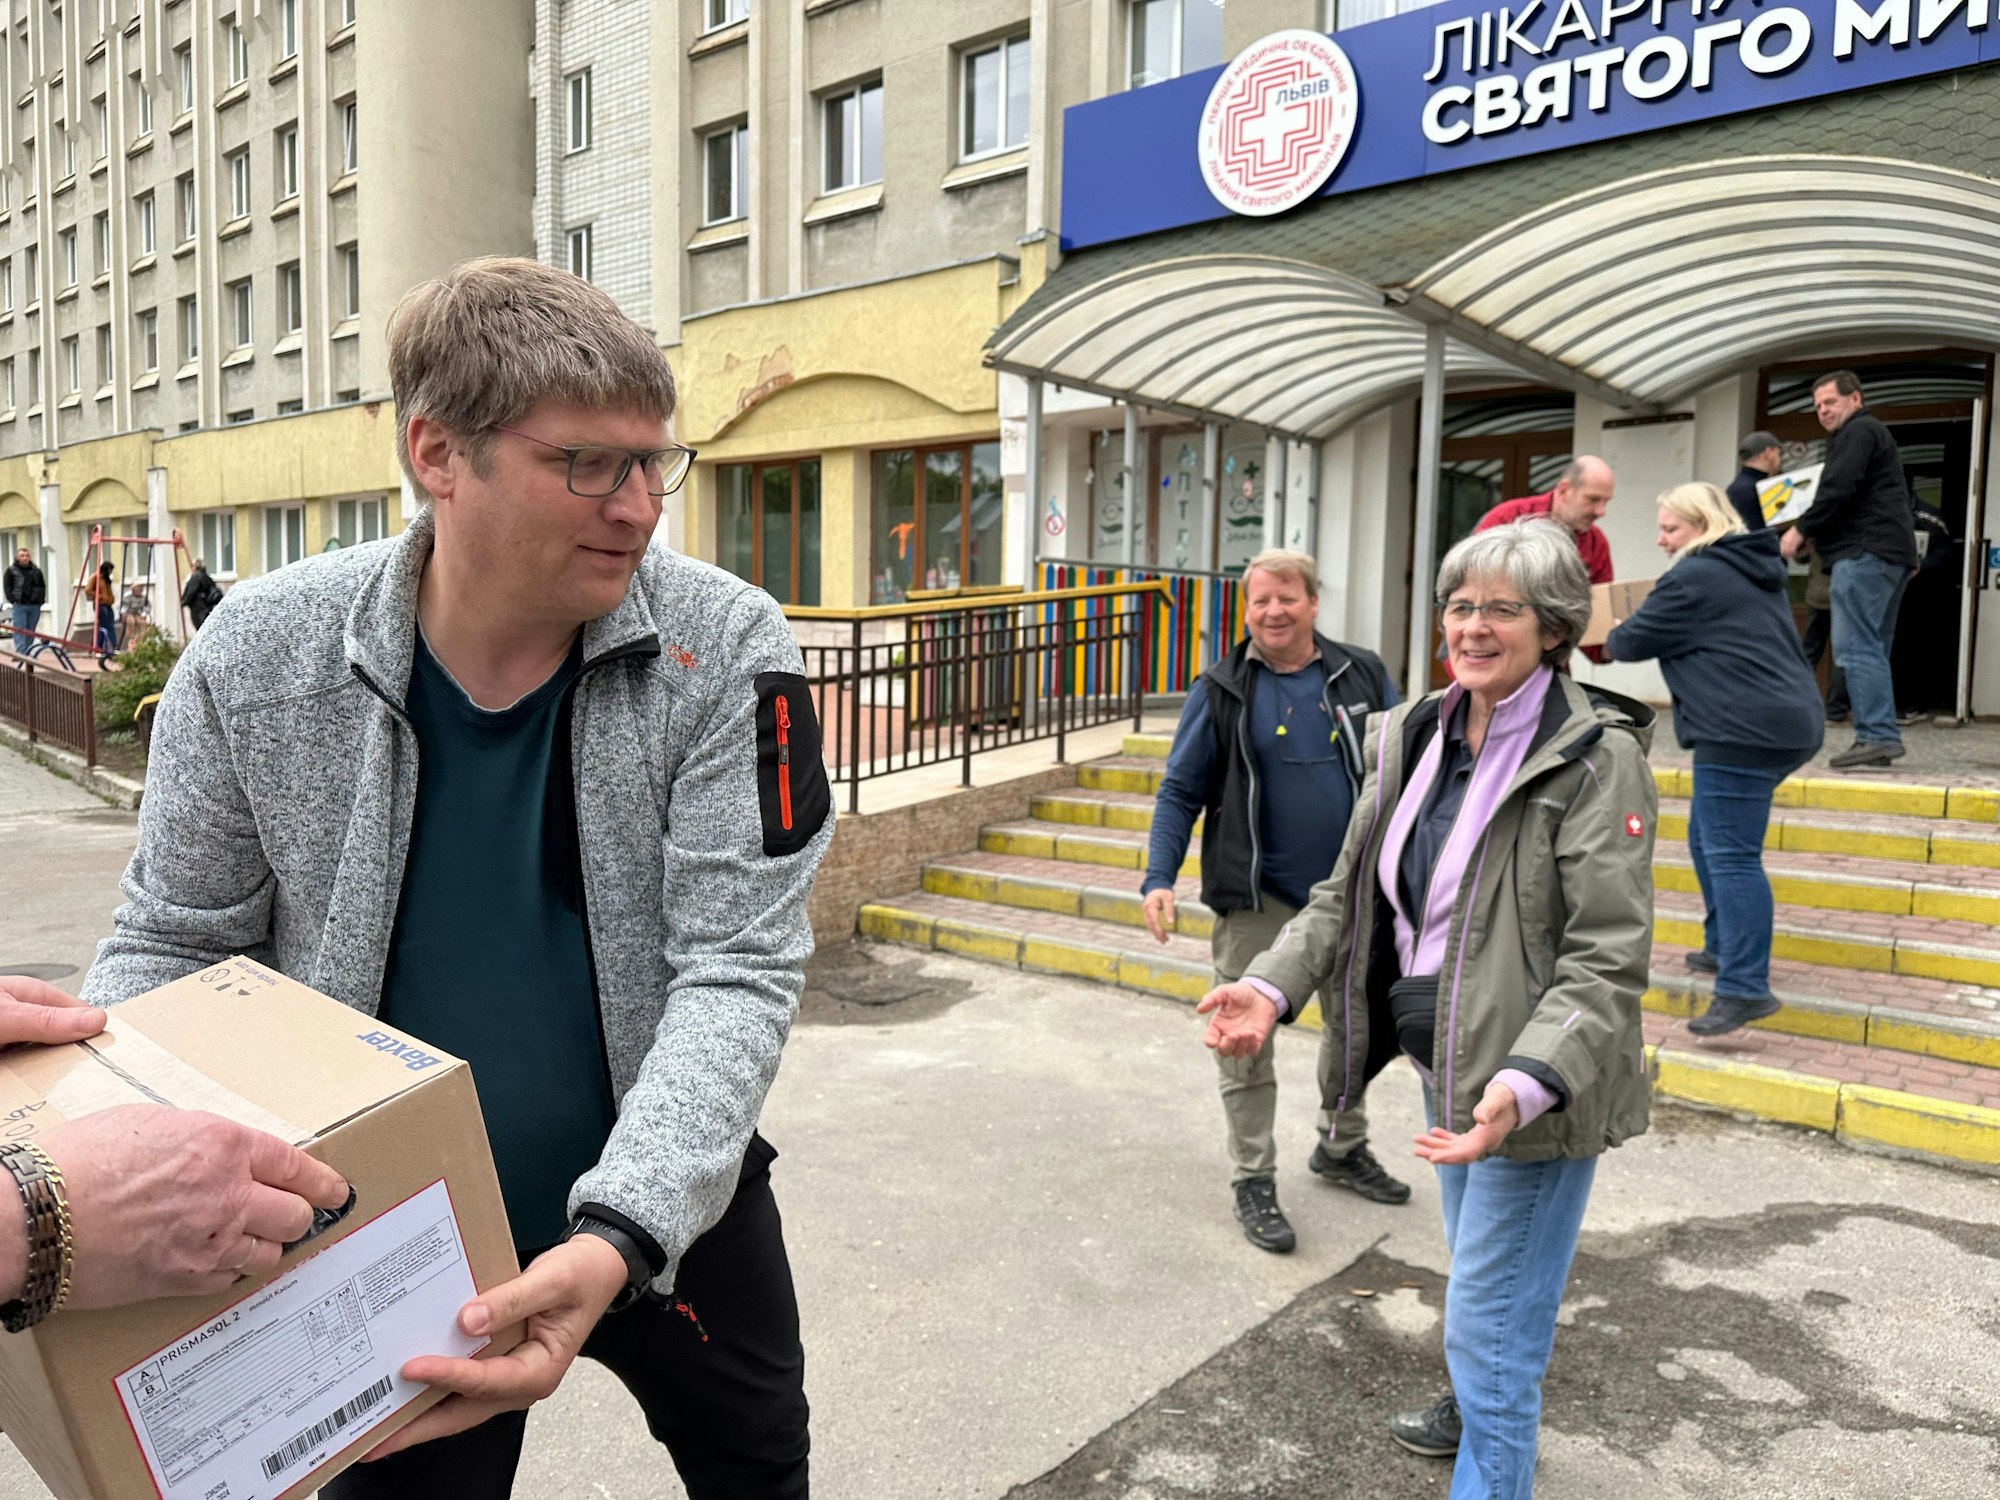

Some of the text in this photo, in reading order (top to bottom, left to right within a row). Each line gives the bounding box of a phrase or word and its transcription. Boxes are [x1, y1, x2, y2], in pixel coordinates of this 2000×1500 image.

[1275, 78, 1330, 106] ЛЬВІВ
[1421, 7, 1812, 144] СВЯТОГО
[355, 1030, 442, 1072] Baxter
[159, 1318, 232, 1367] PRISMASOL
[232, 1311, 241, 1321] 2
[274, 1279, 299, 1297] Kalium
[140, 1371, 150, 1381] A
[145, 1384, 155, 1395] B
